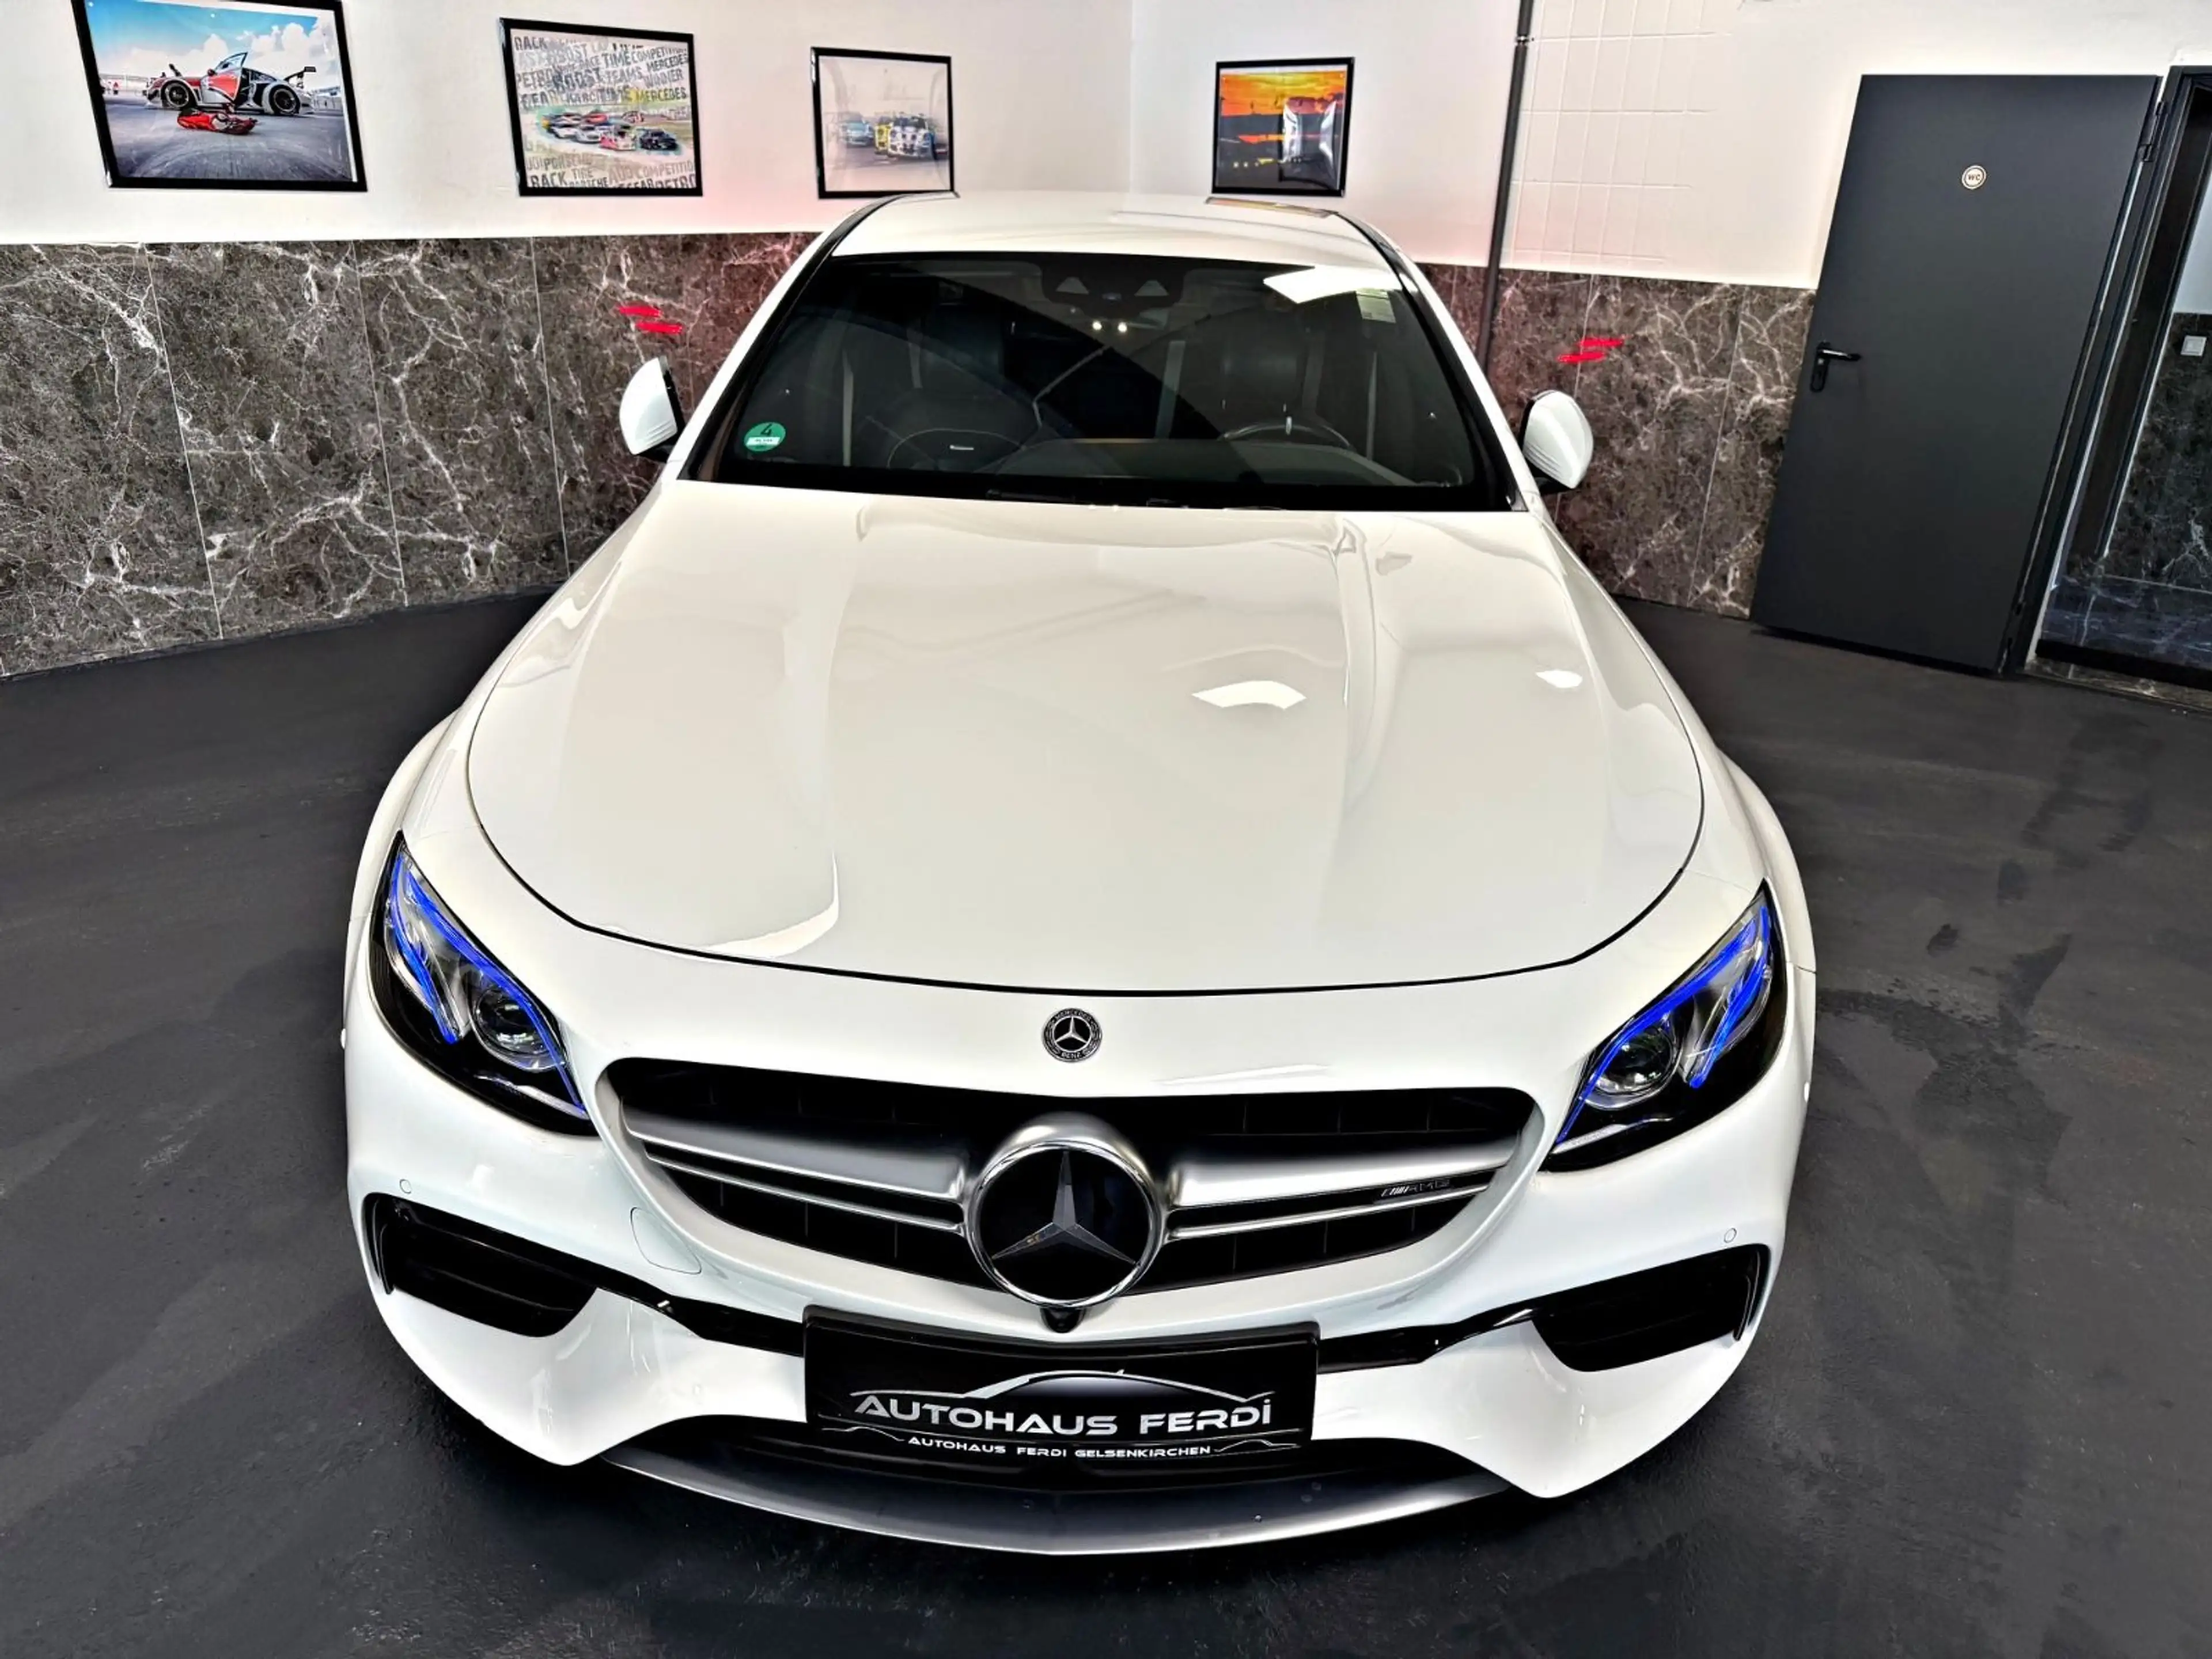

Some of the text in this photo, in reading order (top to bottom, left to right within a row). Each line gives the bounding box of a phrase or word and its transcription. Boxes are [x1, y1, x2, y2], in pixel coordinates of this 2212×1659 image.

[760, 423, 773, 436] 4
[854, 1395, 1118, 1435] AUTOHAUS
[908, 1437, 1211, 1458] AUTOHAUS FERDI GELSENKIRCHEN
